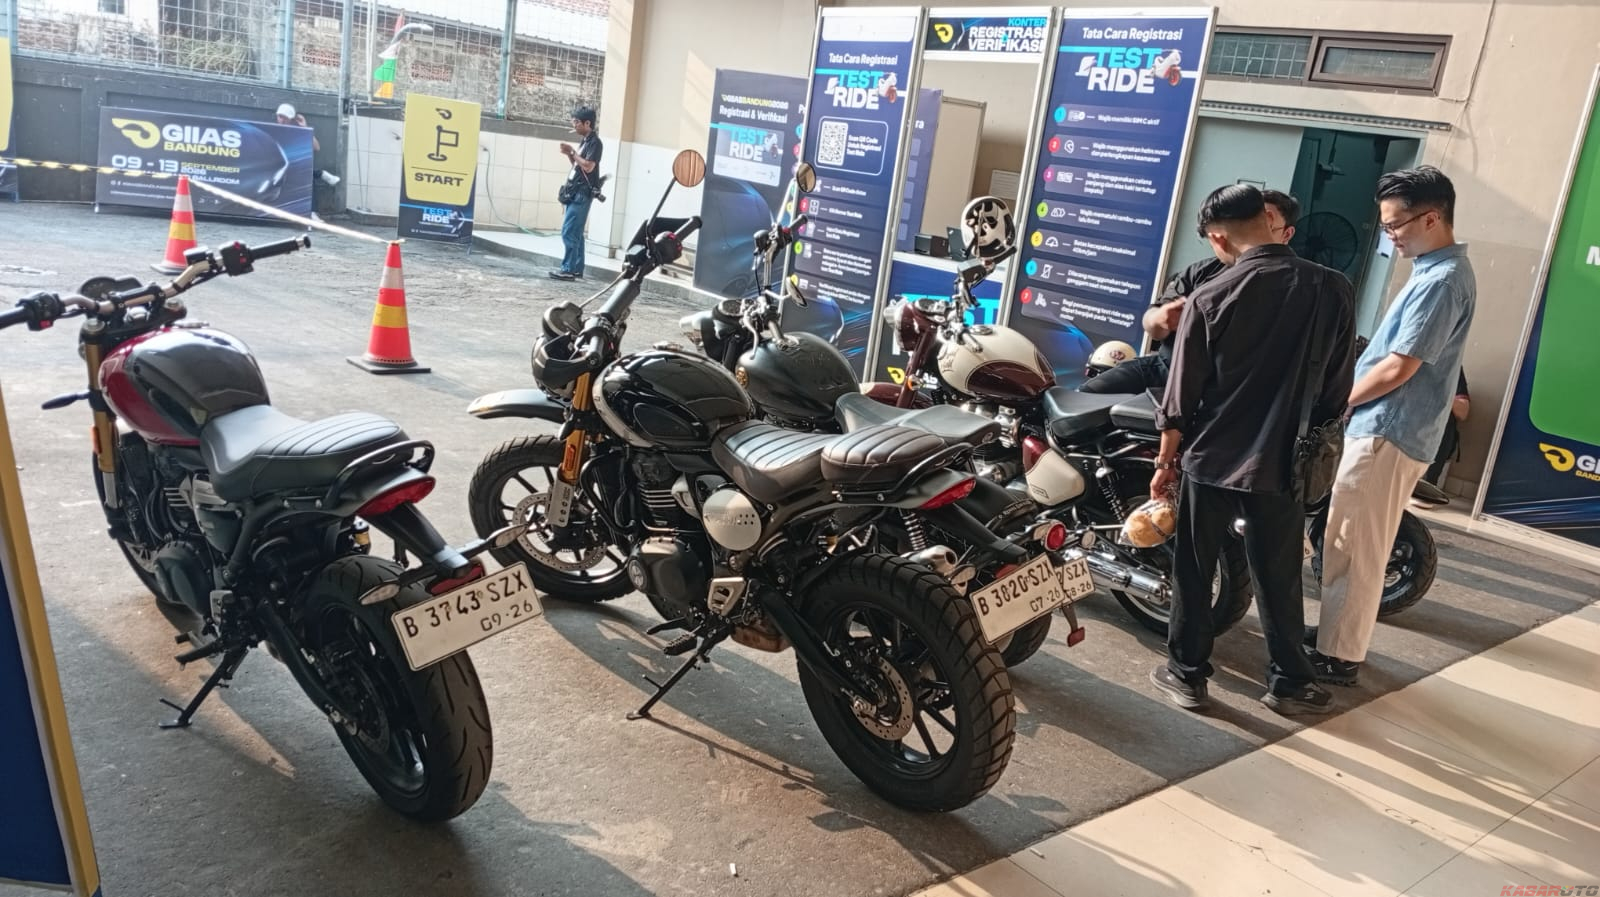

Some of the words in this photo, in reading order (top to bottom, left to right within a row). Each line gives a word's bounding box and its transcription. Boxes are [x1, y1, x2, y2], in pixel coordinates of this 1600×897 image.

[1008, 17, 1047, 27] KONTER
[969, 26, 1047, 39] REGISTRASI
[1083, 27, 1103, 39] Tata
[1104, 27, 1127, 39] Cara
[1129, 29, 1183, 42] Registrasi
[968, 38, 1043, 52] VERIFIKASI
[829, 53, 842, 64] Tata
[843, 53, 860, 64] Cara
[861, 54, 898, 67] Registrasi
[1097, 46, 1162, 69] TEST
[837, 70, 884, 88] TEST
[1087, 66, 1155, 94] RIDE
[833, 87, 880, 109] RIDE
[719, 105, 751, 118] Registrasi
[162, 123, 242, 148] GIIAS
[730, 127, 768, 145] TEST
[163, 141, 241, 158] BANDUNG
[728, 141, 764, 162] RIDE
[111, 154, 143, 169] 09
[158, 159, 179, 173] 13
[180, 161, 241, 173] SEPTEMBER
[414, 172, 465, 187] START
[422, 212, 451, 224] RIDE
[1066, 563, 1088, 580] SZX
[977, 597, 990, 616] B
[1027, 560, 1054, 586] SZX
[402, 616, 419, 638] B
[425, 591, 481, 627] 3743
[486, 570, 528, 602] SZX
